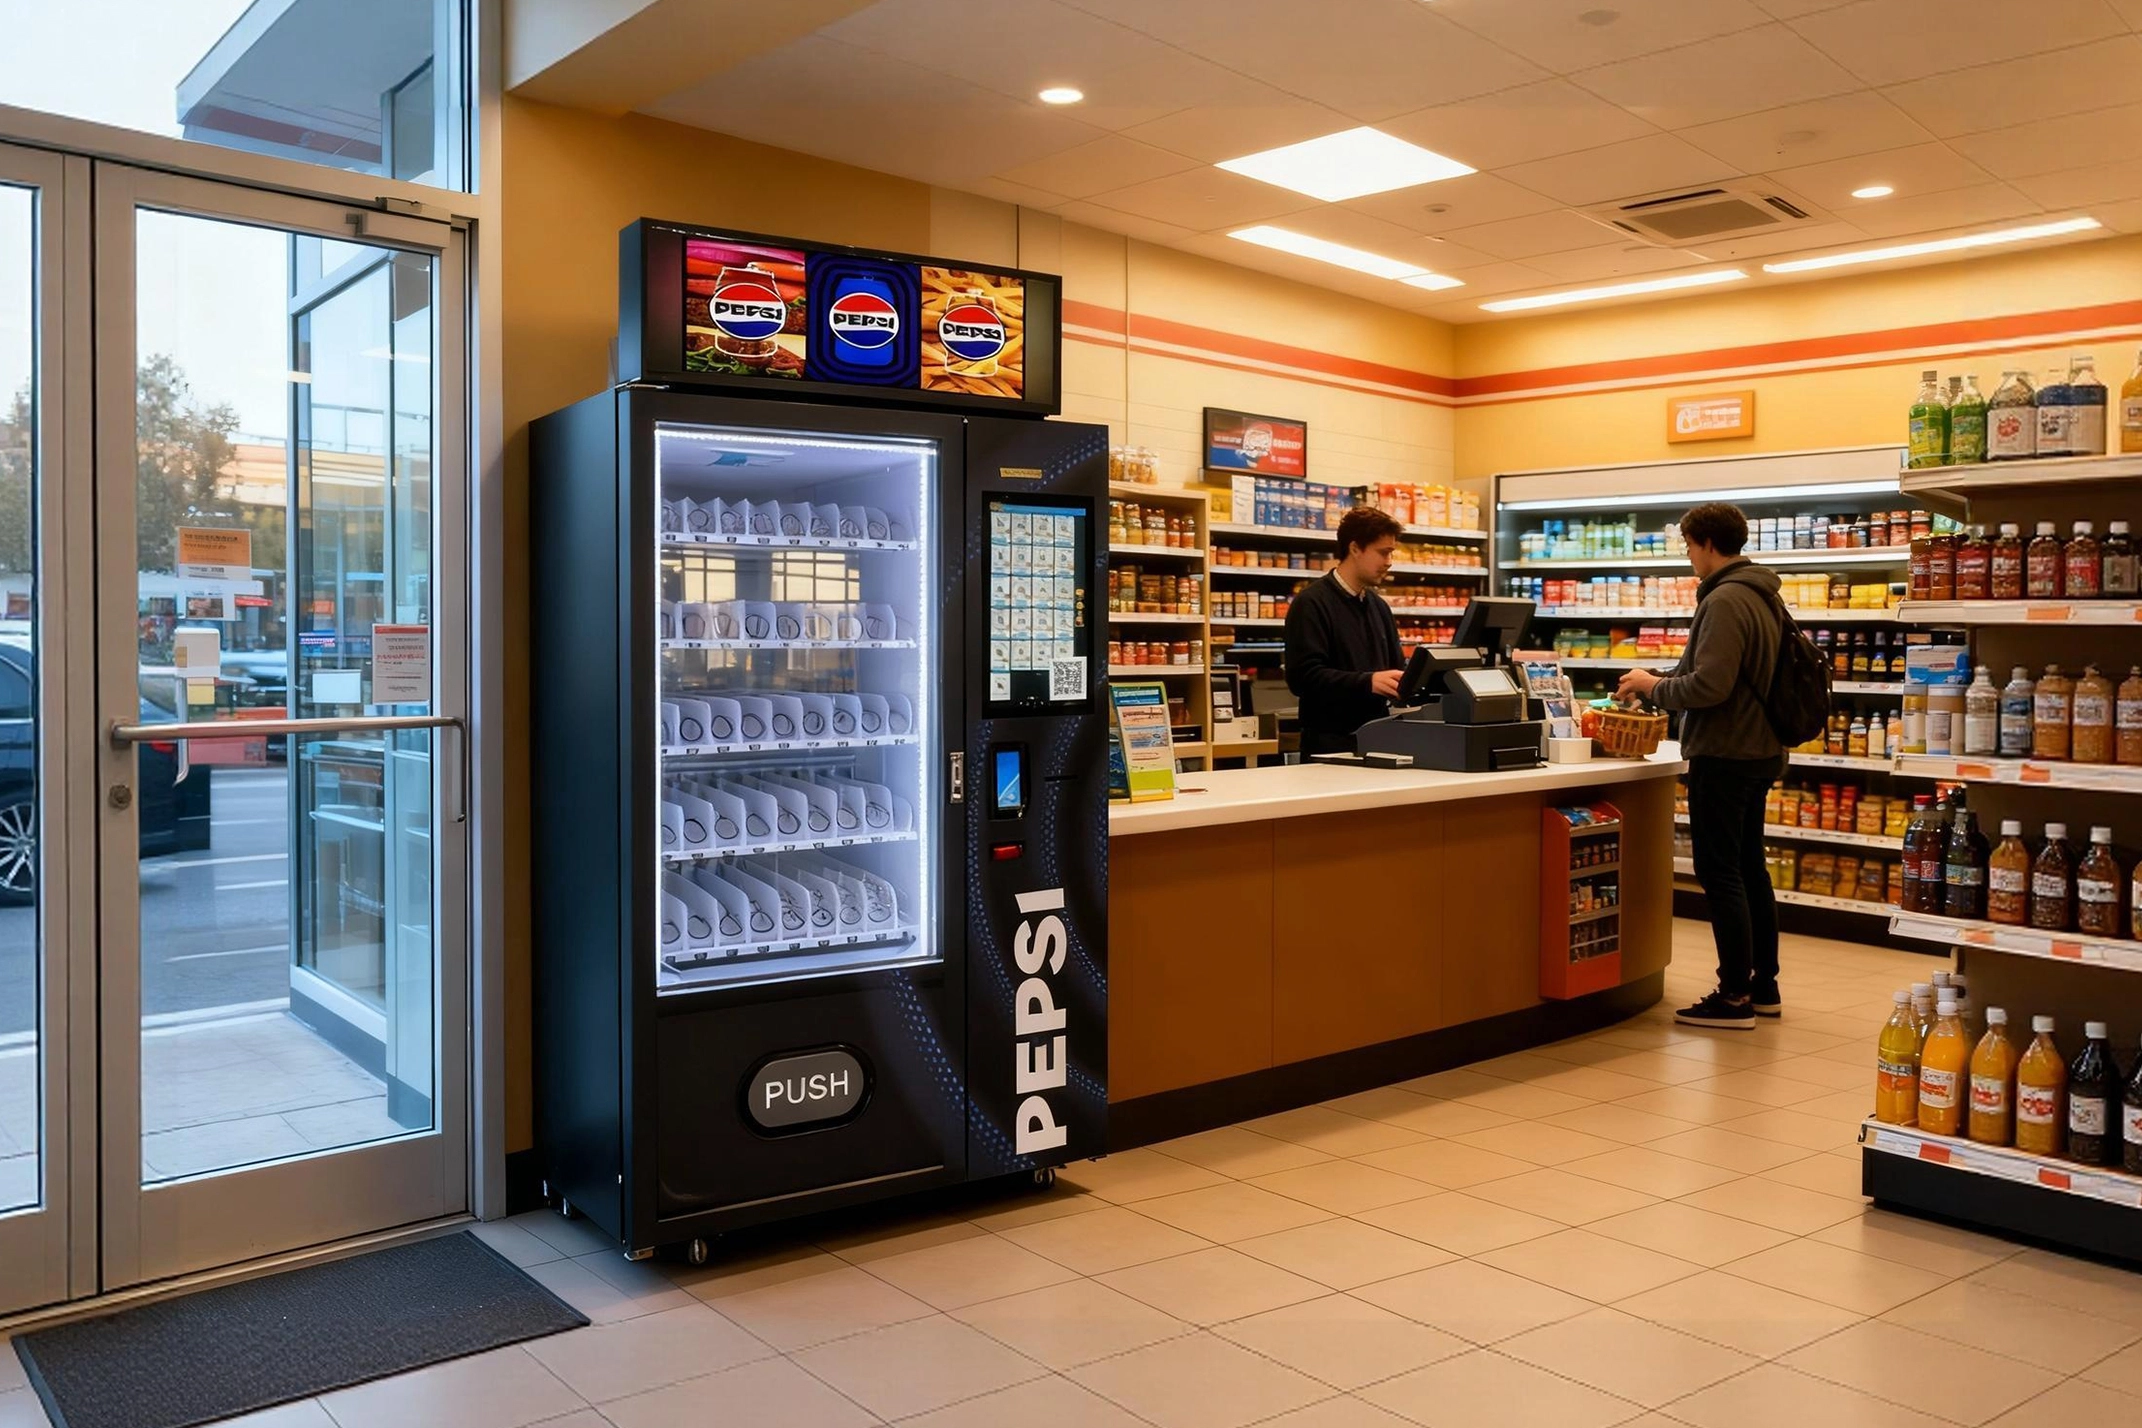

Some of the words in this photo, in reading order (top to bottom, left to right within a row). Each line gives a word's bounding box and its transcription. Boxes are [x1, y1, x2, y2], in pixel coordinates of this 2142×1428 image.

[833, 312, 895, 330] PEPSI
[1013, 887, 1068, 1156] PEPSI
[765, 1063, 849, 1110] PUSH
